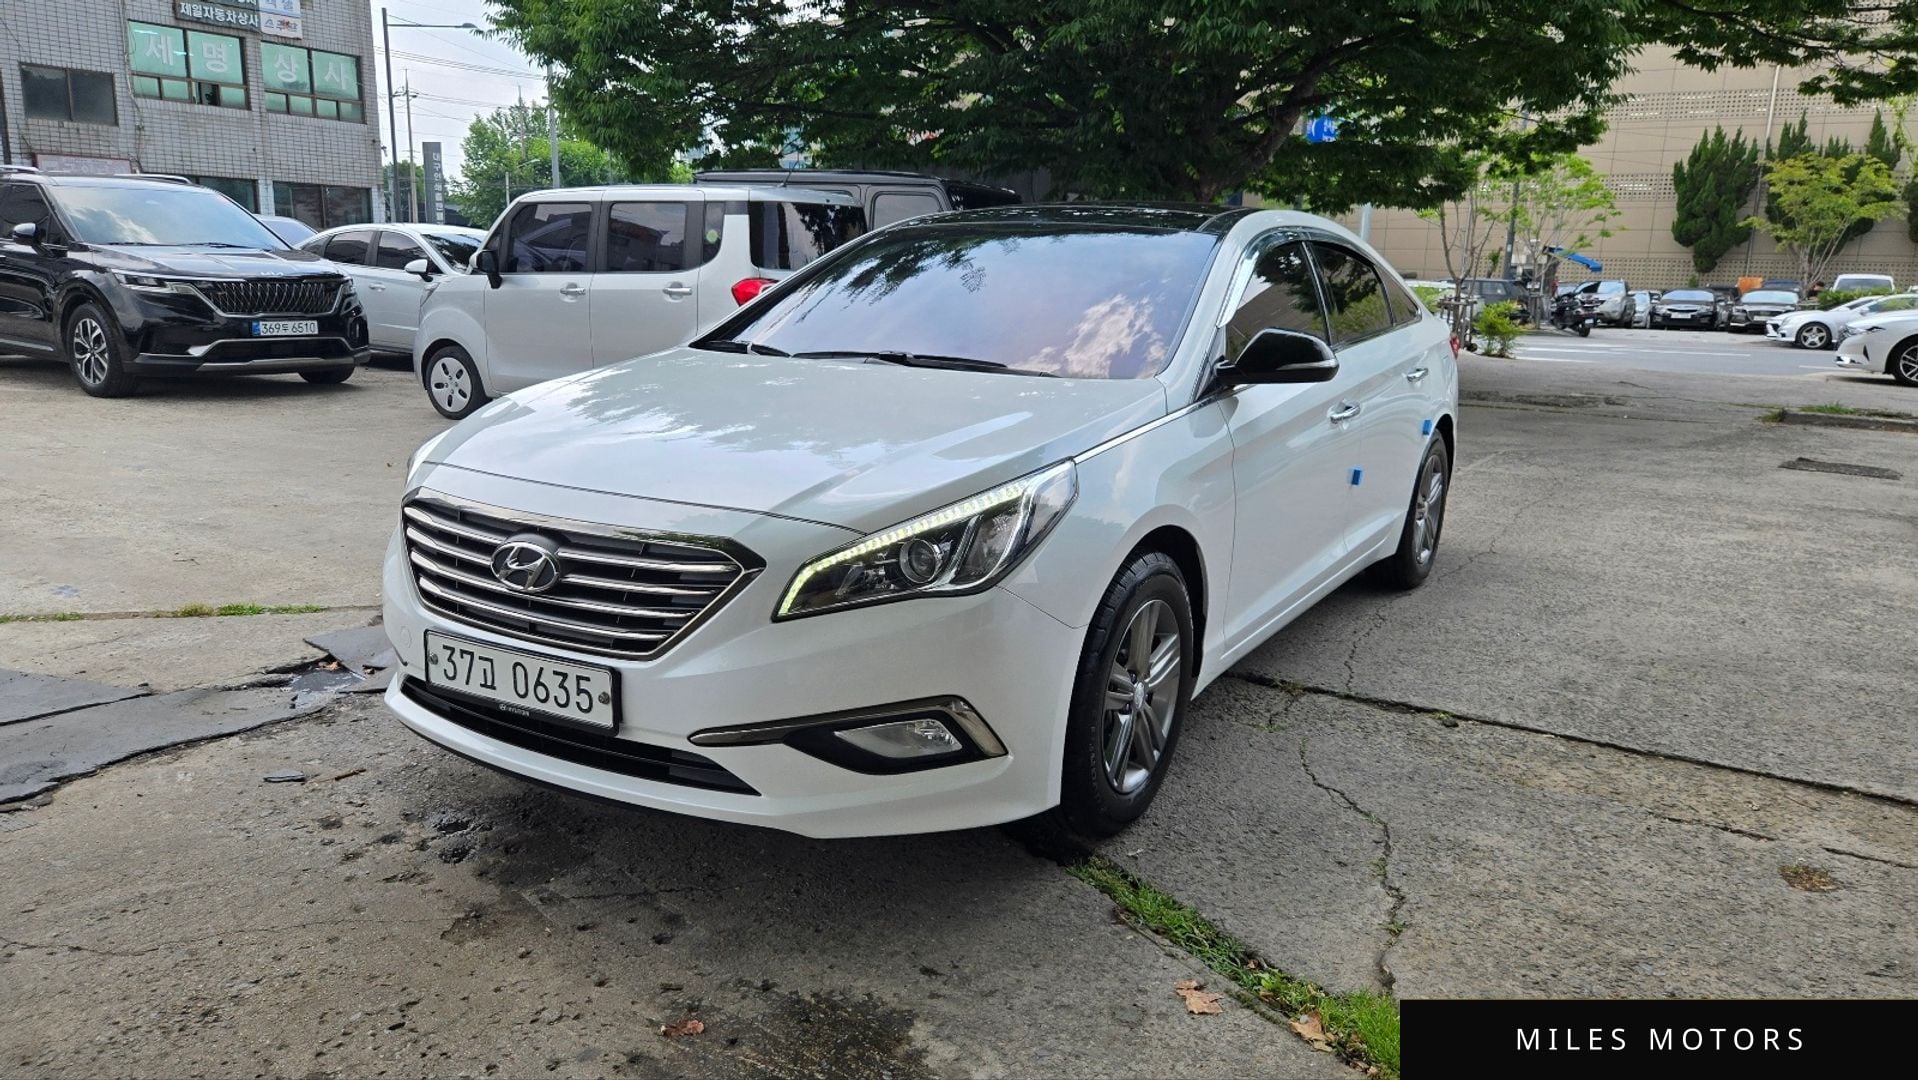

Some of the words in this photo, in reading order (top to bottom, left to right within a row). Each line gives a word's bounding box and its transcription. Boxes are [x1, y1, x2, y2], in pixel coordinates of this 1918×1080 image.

[180, 2, 259, 27] 제일자동차상사
[291, 322, 316, 334] 6510
[442, 644, 497, 691] 37고
[512, 661, 594, 714] 0635
